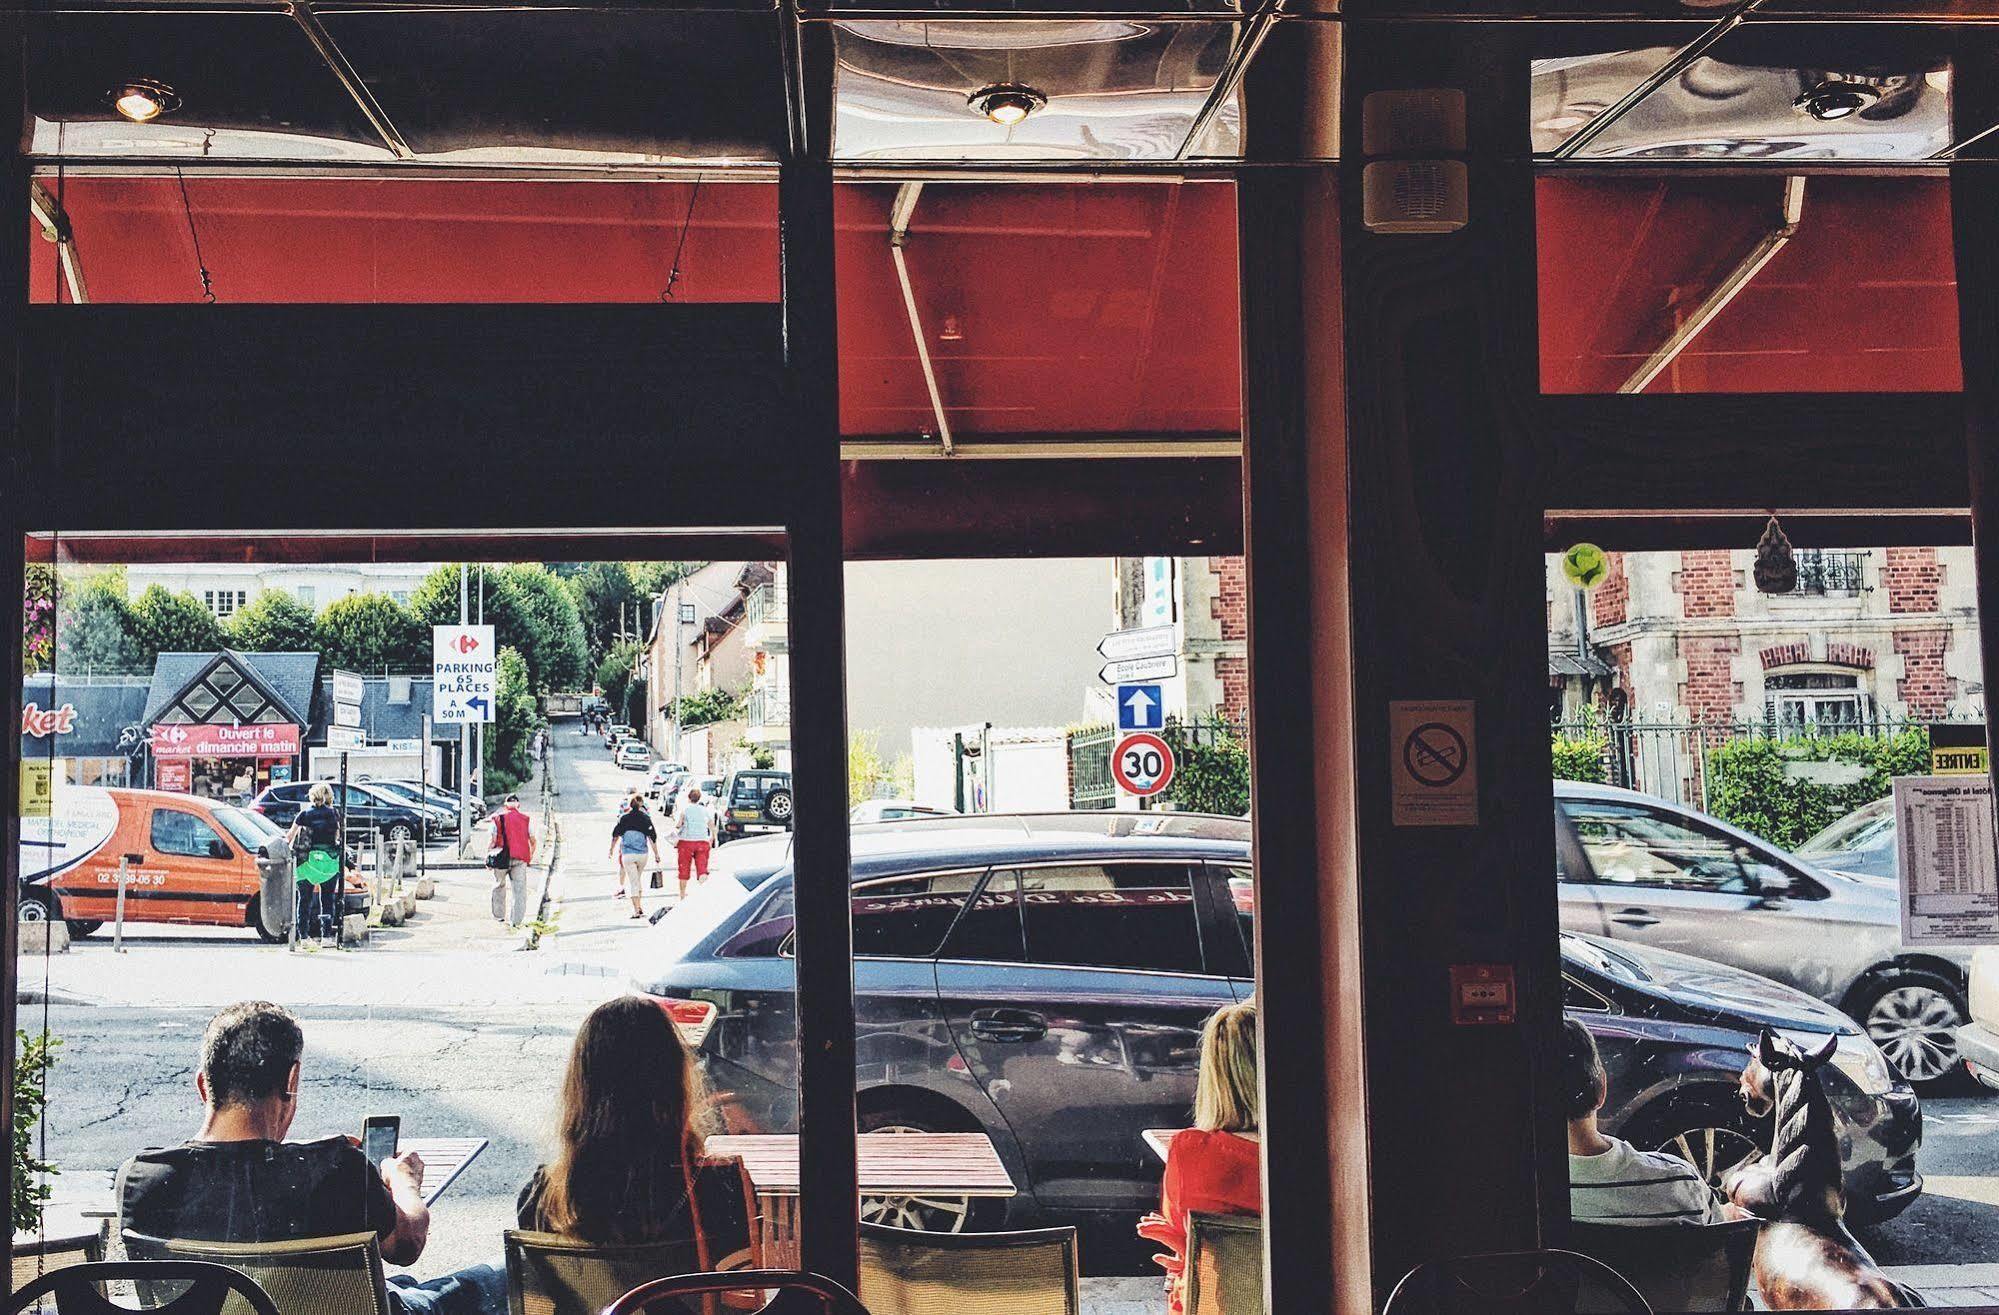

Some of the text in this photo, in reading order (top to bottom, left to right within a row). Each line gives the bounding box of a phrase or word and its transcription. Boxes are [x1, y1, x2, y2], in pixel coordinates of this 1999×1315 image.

[436, 663, 493, 673] PARKING
[456, 674, 473, 684] 65
[439, 683, 490, 693] PLACES
[450, 699, 457, 707] A
[442, 710, 465, 718] 50 M
[218, 727, 275, 740] Ouvert le
[155, 745, 191, 754] market
[196, 741, 297, 754] dimanche matin
[1124, 751, 1162, 778] 30
[97, 873, 110, 884] 02
[152, 875, 165, 886] 30
